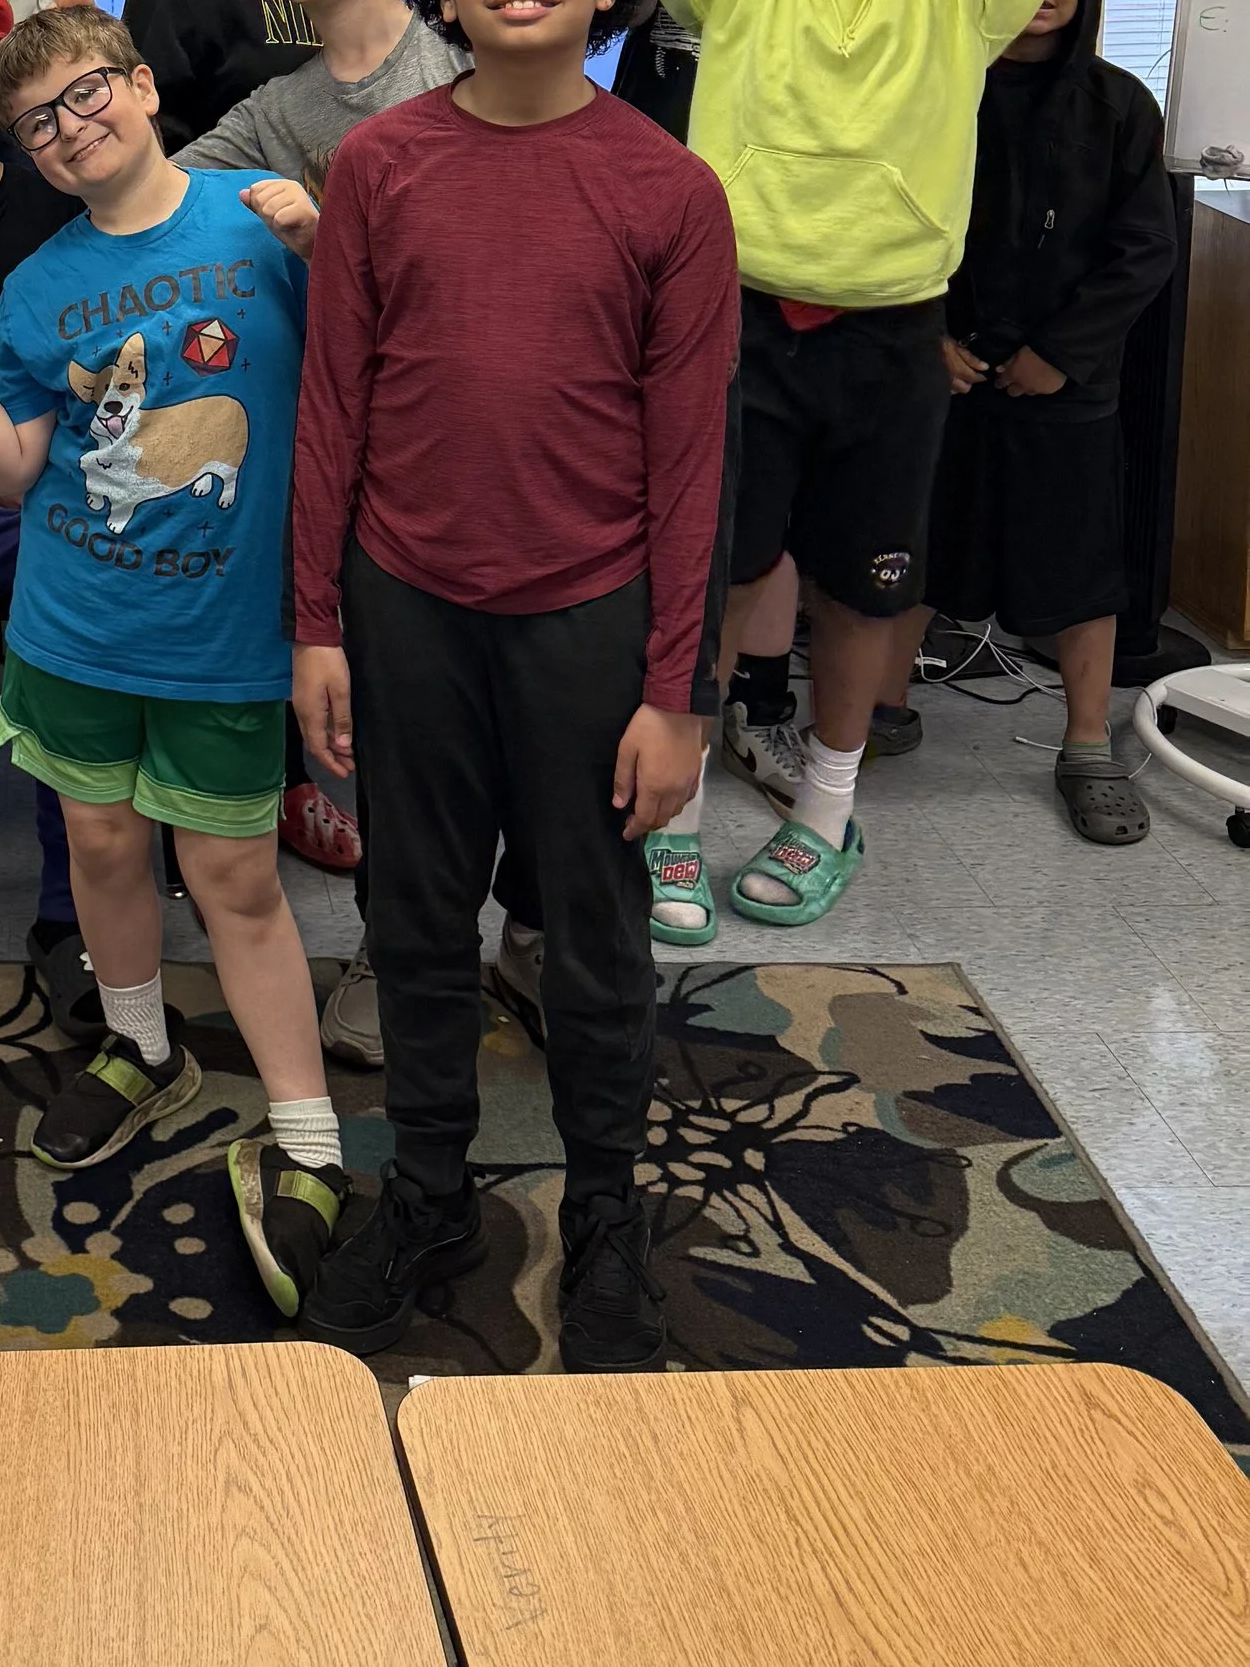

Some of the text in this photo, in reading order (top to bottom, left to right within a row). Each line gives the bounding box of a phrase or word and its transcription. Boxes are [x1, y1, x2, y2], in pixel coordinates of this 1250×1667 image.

[57, 259, 255, 341] CHAOTIC
[47, 503, 237, 579] GOOD BOY
